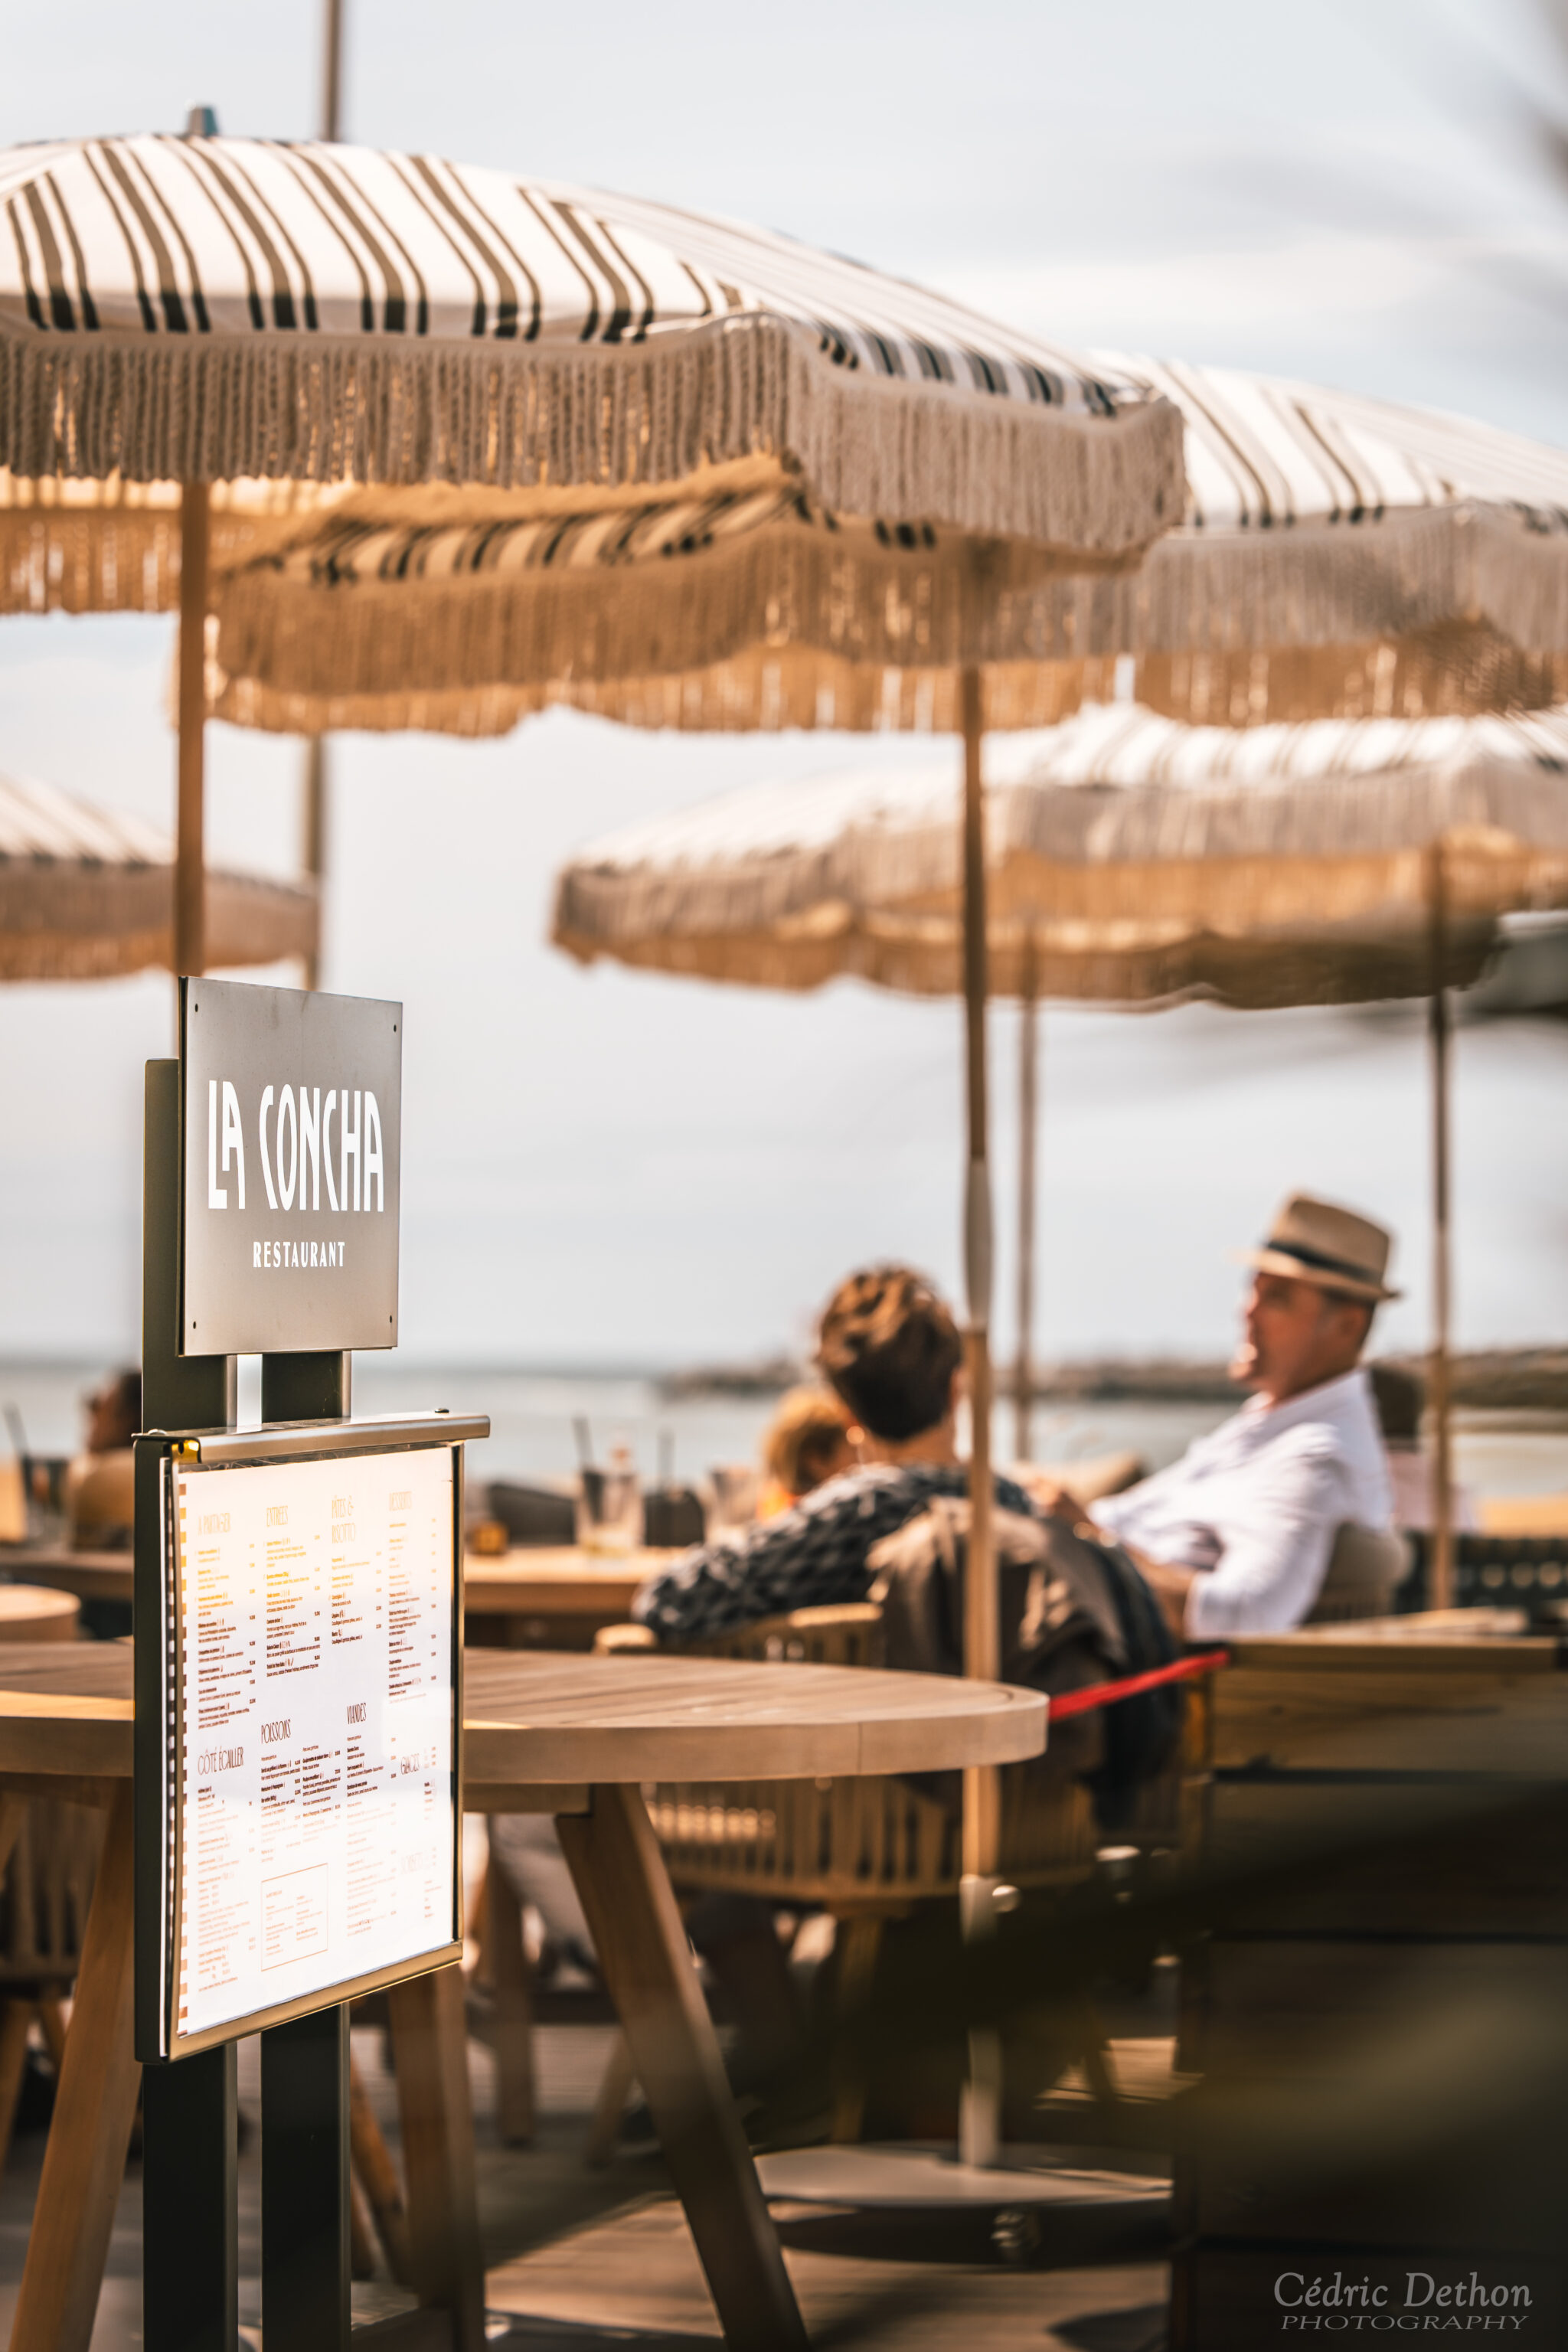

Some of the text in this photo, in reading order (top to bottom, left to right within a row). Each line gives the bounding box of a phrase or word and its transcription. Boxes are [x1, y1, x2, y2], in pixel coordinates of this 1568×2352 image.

[207, 1080, 384, 1212] LA CONCHA
[253, 1241, 346, 1269] RESTAURANT
[332, 1494, 346, 1519] PÂTES
[332, 1523, 355, 1544] RISOTTO
[347, 1702, 367, 1725] VIANDES
[261, 1719, 291, 1744] POISSONS
[198, 1746, 244, 1775] CÔTÉ ÉCAILLER
